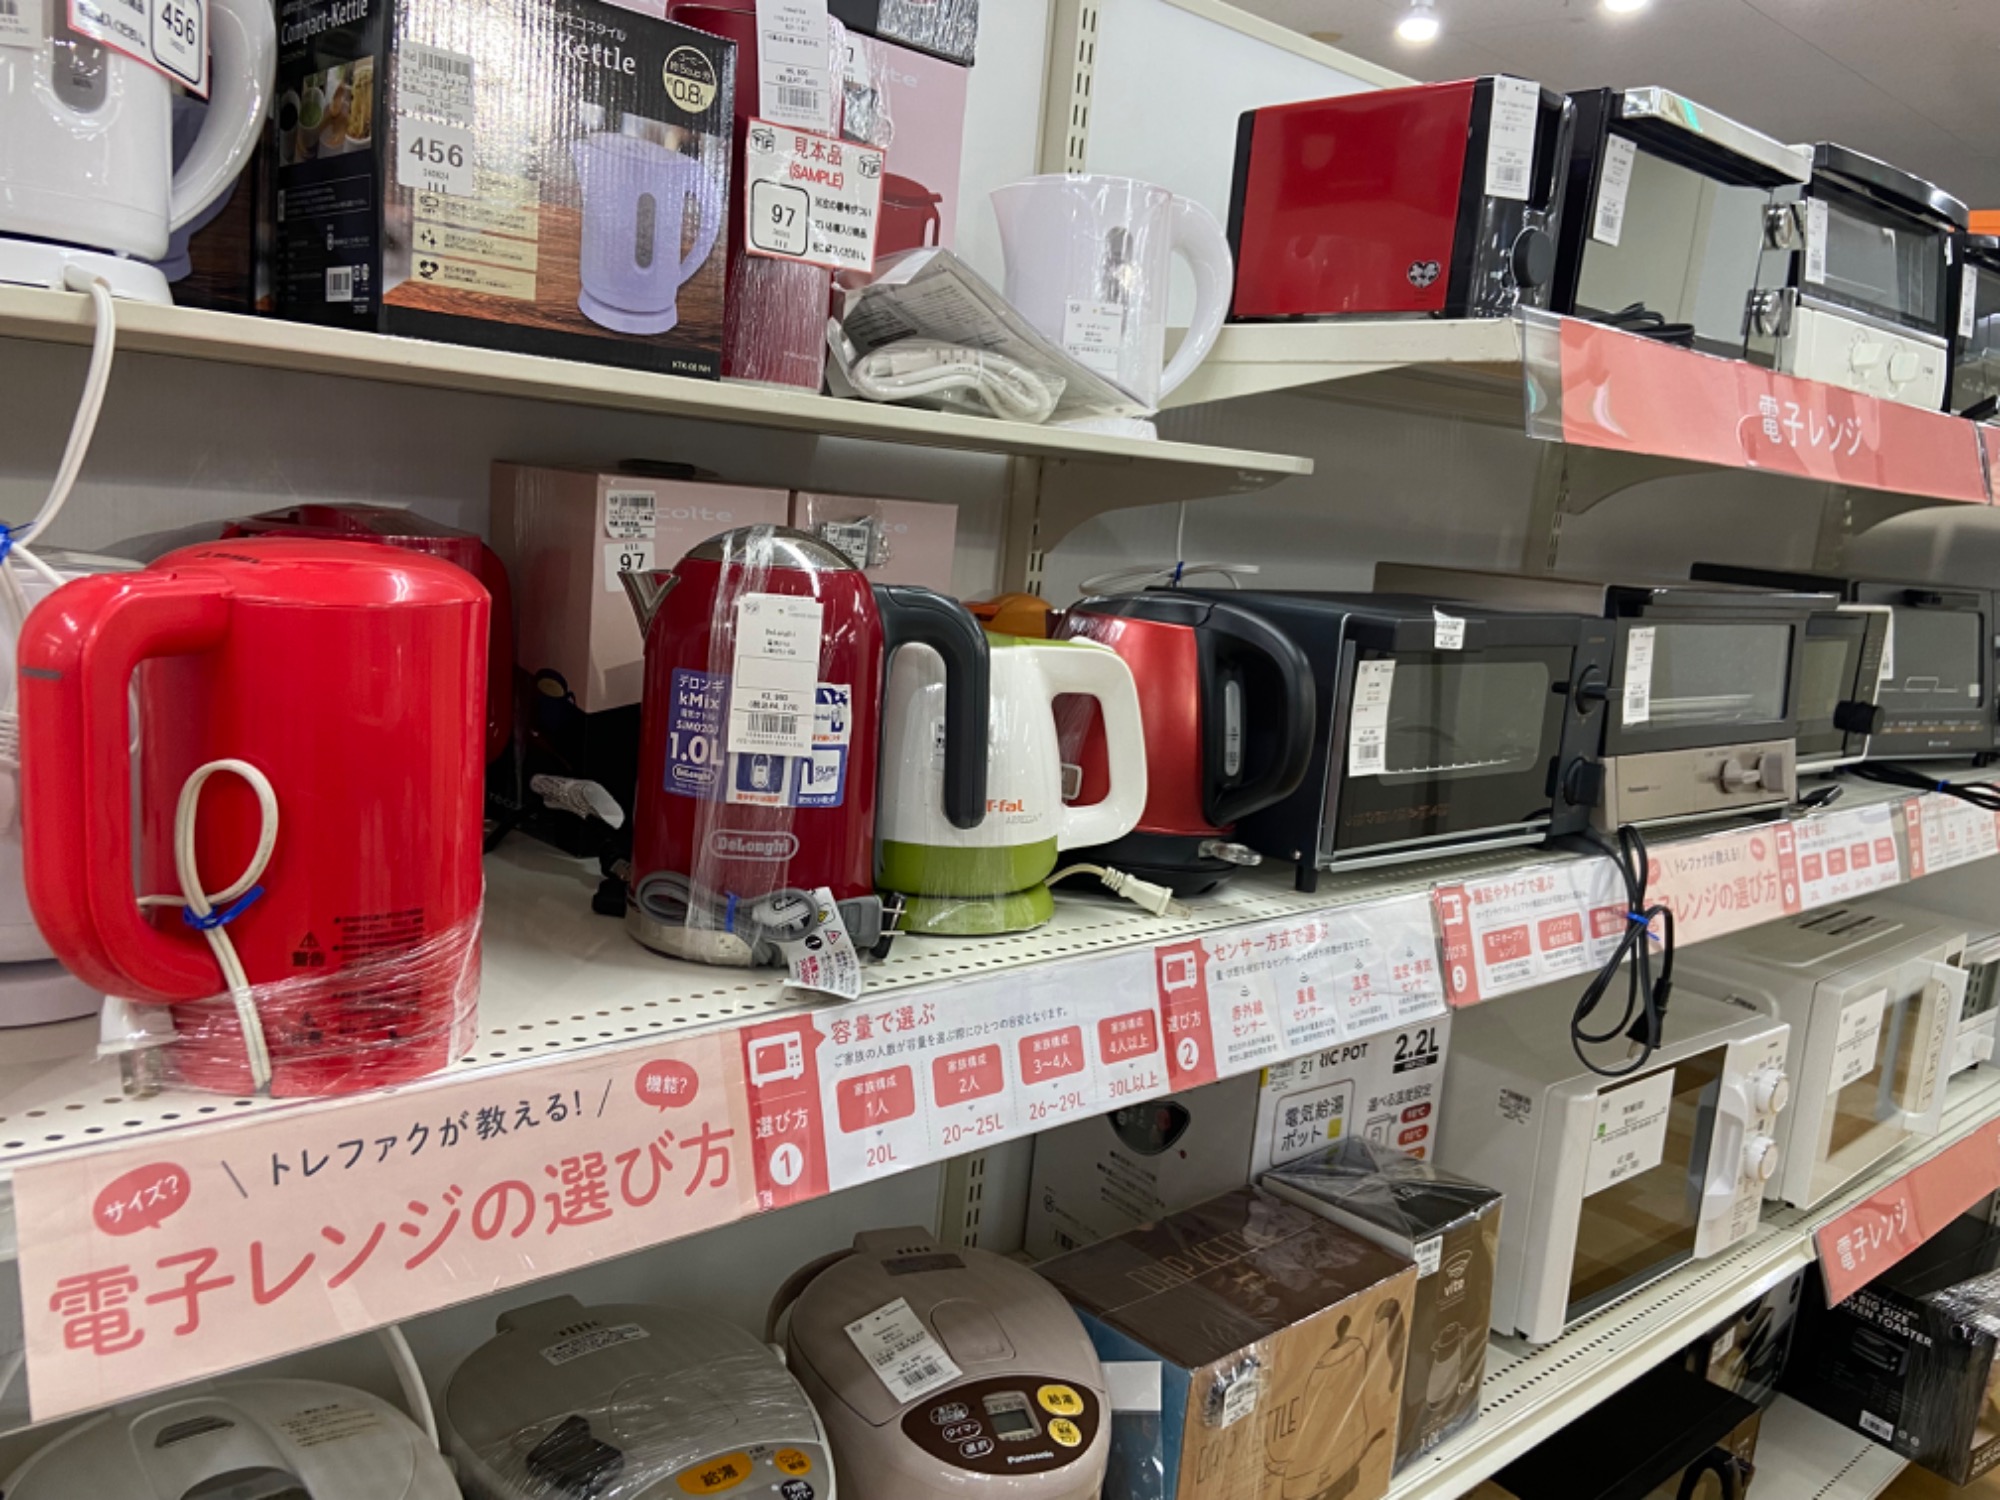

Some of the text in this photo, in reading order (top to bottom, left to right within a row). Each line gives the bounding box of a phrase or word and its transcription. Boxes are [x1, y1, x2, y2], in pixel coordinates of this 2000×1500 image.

[162, 2, 195, 45] 456
[560, 33, 636, 74] Kettle
[409, 136, 463, 168] 456
[795, 136, 842, 166] 見本品
[789, 161, 844, 190] (SAMPLE)
[771, 204, 796, 227] 97
[1758, 394, 1863, 455] 電子レンジ
[620, 552, 645, 571] 97
[679, 674, 724, 692] デロンギ
[679, 690, 720, 709] kMix
[670, 732, 724, 766] 1.0L
[717, 837, 788, 856] DeLonghi
[830, 1003, 936, 1046] 容量で選ぶ
[1167, 1010, 1201, 1033] 選び方
[1293, 1005, 1325, 1022] センサー
[1232, 1020, 1267, 1039] センサー
[1109, 1033, 1150, 1054] 4人以上
[1341, 1043, 1369, 1063] POT
[1393, 1026, 1439, 1063] 2.2L
[645, 1073, 688, 1096] 機能?
[853, 1074, 897, 1096] 家族構成
[958, 1074, 980, 1094] 2人
[1108, 1071, 1159, 1099] 30L以上
[866, 1099, 889, 1118] 1人
[755, 1107, 809, 1140] 選び方
[270, 1091, 584, 1187] トレファクが教える!
[1281, 1124, 1323, 1152] ポット
[866, 1142, 897, 1168] 20L
[104, 1175, 180, 1224] サイズ?
[49, 1121, 736, 1356] 電子レンジの選び方
[1836, 1198, 1908, 1271] 電子レンジ
[1882, 1306, 1909, 1326] SIZE
[1877, 1314, 1934, 1348] TOASTER
[1006, 1450, 1055, 1465] Panasonic
